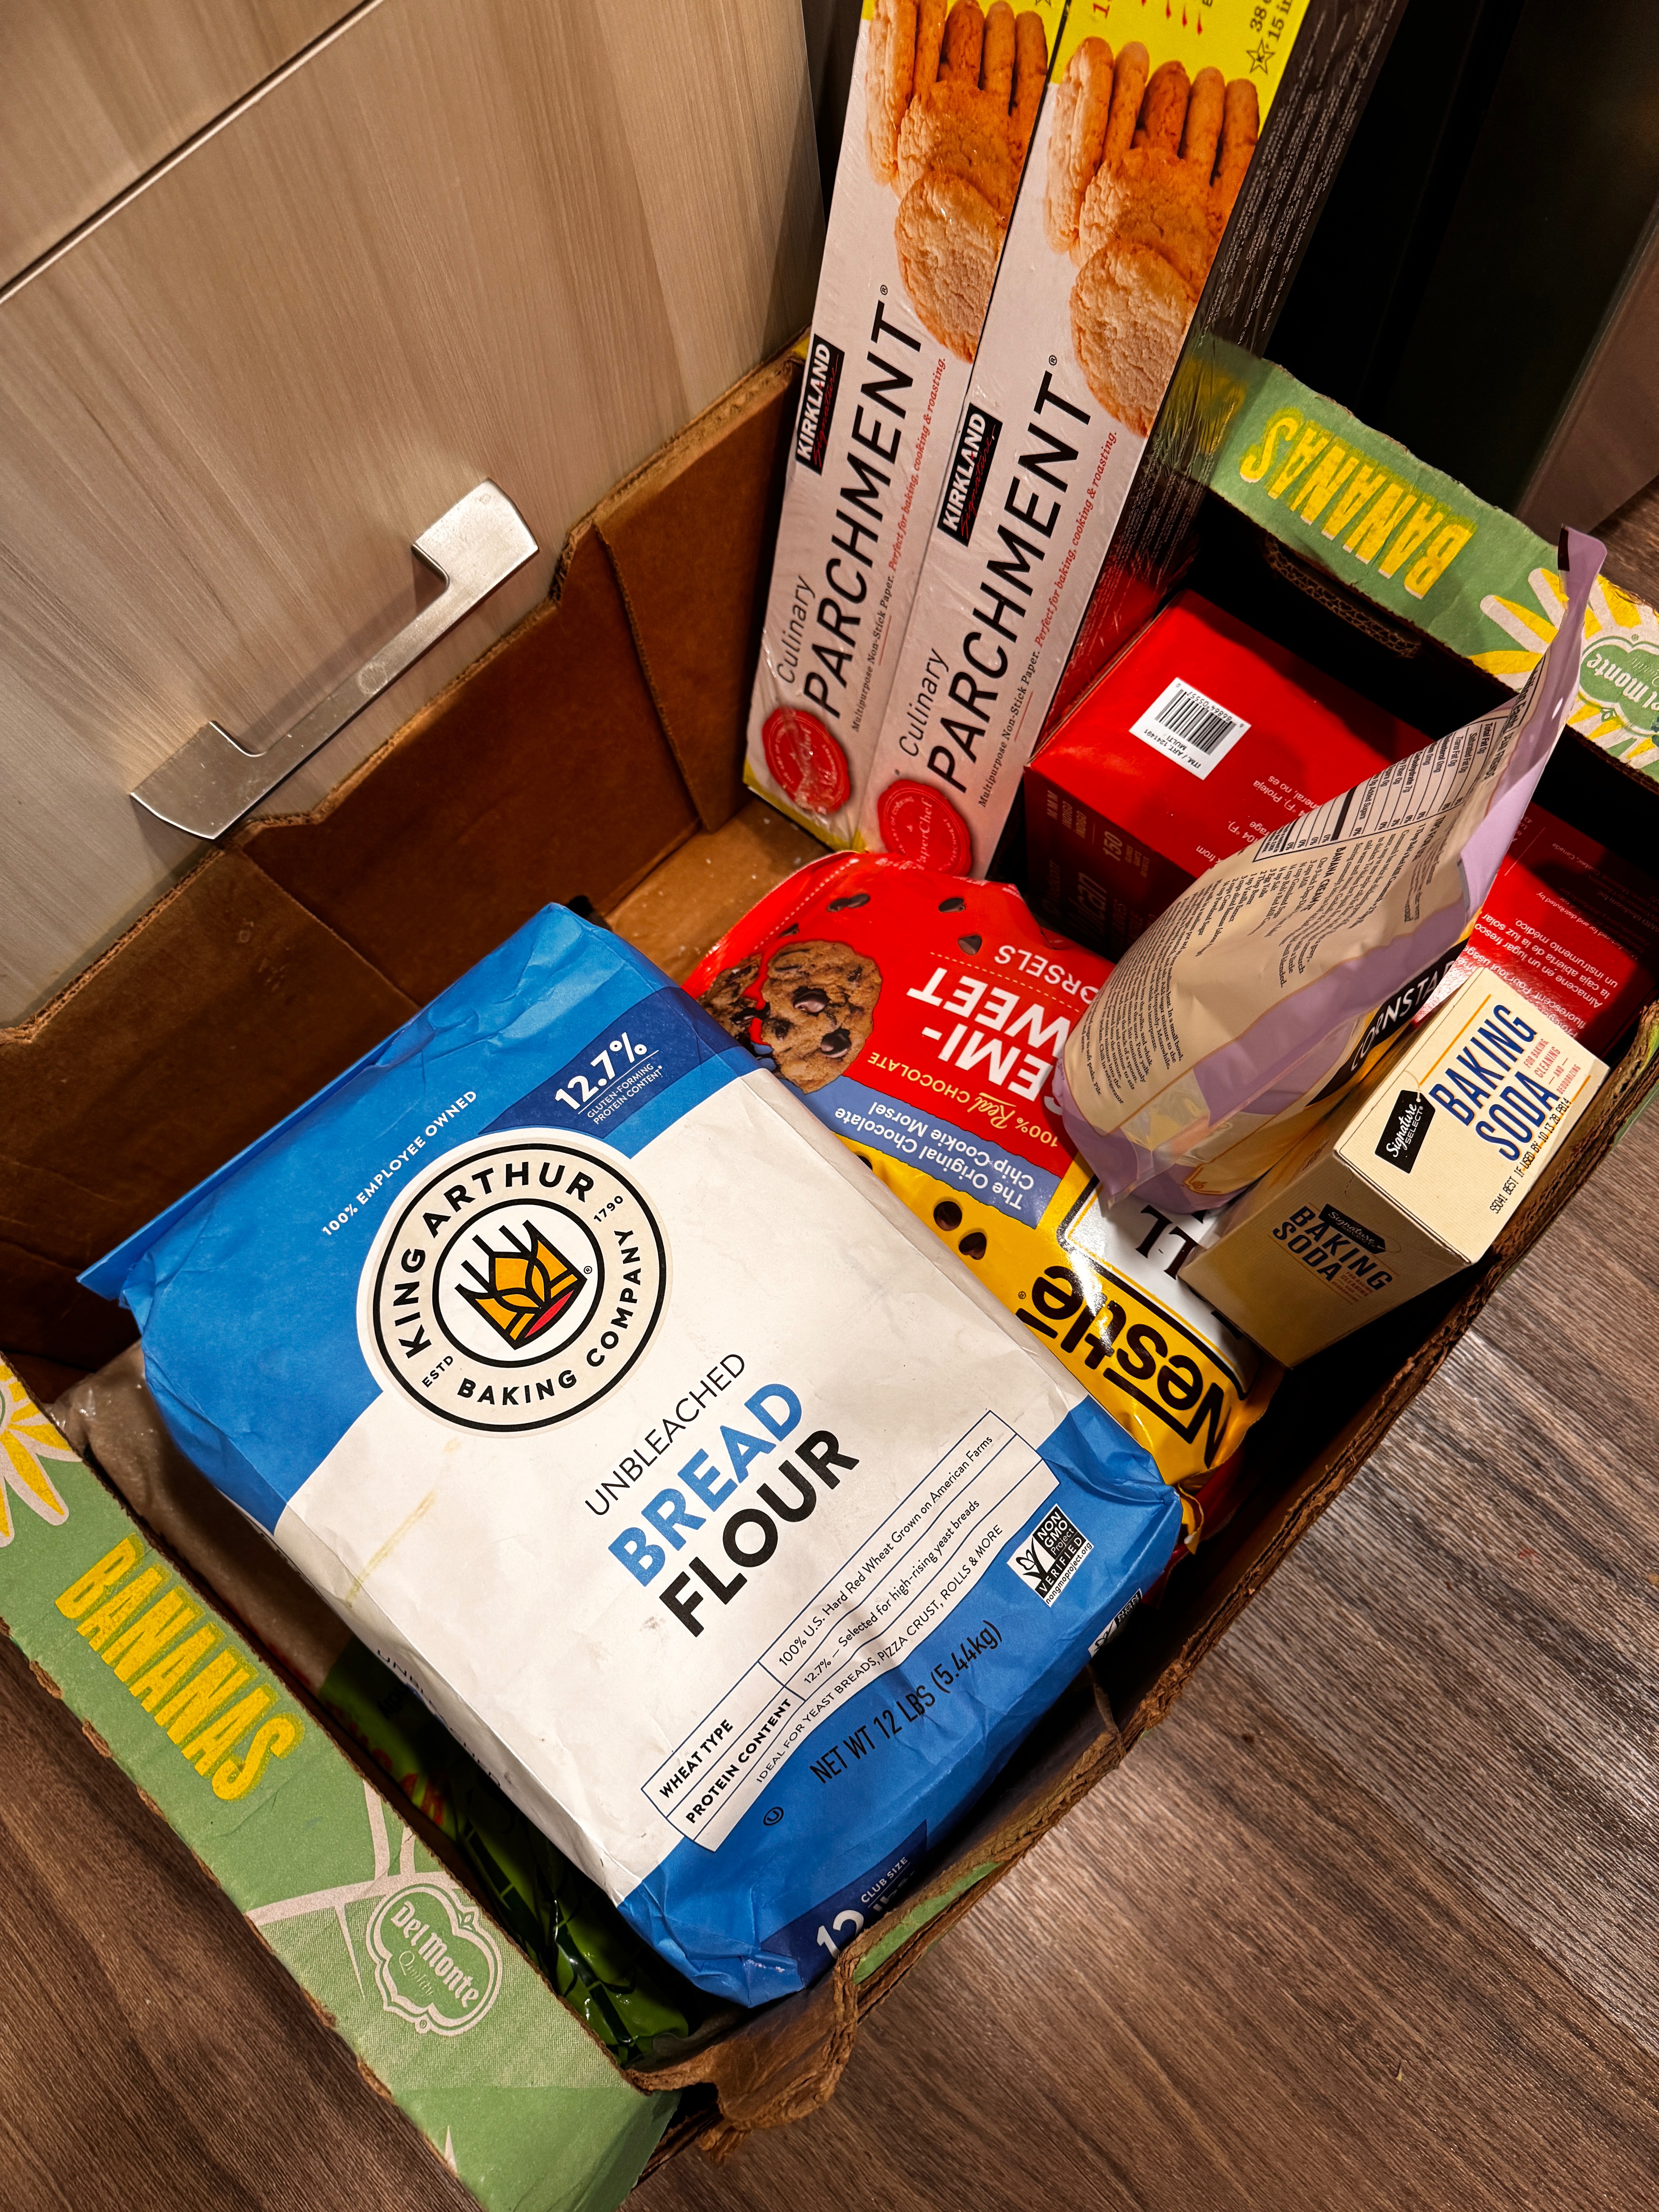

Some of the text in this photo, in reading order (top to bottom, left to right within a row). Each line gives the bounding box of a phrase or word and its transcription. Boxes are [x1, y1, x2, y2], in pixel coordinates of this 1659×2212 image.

[796, 344, 835, 460] KIRKLAND
[804, 301, 921, 717] PARCHMENT
[944, 414, 985, 530] KIRKLAND
[1241, 413, 1476, 600] BANANAS
[852, 359, 945, 731] Multipurpose Non-Stick Paper. Perfect for baking, cooking & roasting.
[928, 371, 1091, 793] PARCHMENT
[777, 575, 815, 683] Culinary
[979, 433, 1116, 807] Multipurpose Non-Stick Paper. Perfect for baking, cooking & roasting.
[899, 648, 949, 756] Culinary
[1587, 654, 1649, 702] Monte
[1167, 736, 1187, 750] MULTI
[1483, 720, 1492, 740] Total
[1254, 781, 1283, 802] Proteja
[1103, 831, 1122, 860] 150
[1324, 847, 1346, 881] BANANA
[994, 944, 1099, 1004] ORSELS
[1472, 923, 1602, 1008] Almacene en un lugar fresco
[1482, 914, 1610, 999] la caja abierta de la luz solar
[1516, 920, 1617, 988] un instrumento médico.
[906, 967, 1070, 1058] WEET
[1168, 1008, 1179, 1042] In small
[555, 1032, 644, 1109] 12.7%
[588, 1064, 653, 1117] GLUTEN-FORMING
[868, 1053, 1061, 1146] 100% Real CHOCOLATE
[1423, 1005, 1537, 1126] BAKING
[1524, 1056, 1535, 1068] FOR
[1535, 1047, 1560, 1077] CLEANING
[594, 1096, 627, 1124] PROTEIN
[868, 1102, 1034, 1190] Chip Cookie Morsel
[1385, 1101, 1419, 1160] Signature
[1405, 1107, 1422, 1144] SELECT
[1476, 1072, 1560, 1161] SODA
[1531, 1141, 1543, 1153] BY
[1538, 1132, 1549, 1143] 10
[1544, 1123, 1556, 1134] 13
[1549, 1114, 1562, 1126] 28
[323, 1092, 476, 1235] 100% EMPLOYEE OWNED
[835, 1108, 1022, 1209] The Original Chocolate
[1503, 1176, 1518, 1195] BEST
[1514, 1166, 1525, 1177] IF
[1520, 1152, 1535, 1169] USED
[593, 1195, 624, 1223] 1790
[1290, 1206, 1392, 1290] BAKING
[393, 1161, 595, 1358] KING ARTHUR
[1273, 1222, 1341, 1281] SODA
[457, 1229, 642, 1405] BAKING COMPANY
[422, 1355, 454, 1388] ESTD
[585, 1354, 744, 1515] UNBLEACHED
[608, 1384, 802, 1587] BREAD
[659, 1431, 859, 1637] FLOUR
[780, 1437, 992, 1666] 100% U.S. Hard Red Wheat Grown on American Farms
[1037, 1512, 1062, 1540] NON
[1039, 1537, 1085, 1592] VERIFIED
[1045, 1520, 1067, 1550] GMO
[1051, 1528, 1077, 1558] Project
[804, 1501, 979, 1683] 12.7% Selected for high-rising yeast breads
[1043, 1540, 1095, 1607] nongmoproject.org
[55, 1535, 306, 1800] BANANAS
[757, 1525, 1002, 1782] IDEAL FOR YEAST BREADS, PIZZA CRUST, ROLLS & MORE
[810, 1620, 1002, 1783] NET WT 12 LBS (5.44kg)
[659, 1719, 733, 1798] WHEAT TYPE
[686, 1699, 790, 1823] PROTEIN CONTENT
[862, 1879, 886, 1902] CLUB
[887, 1857, 907, 1878] SIZE
[388, 1899, 478, 2007] Del Monte
